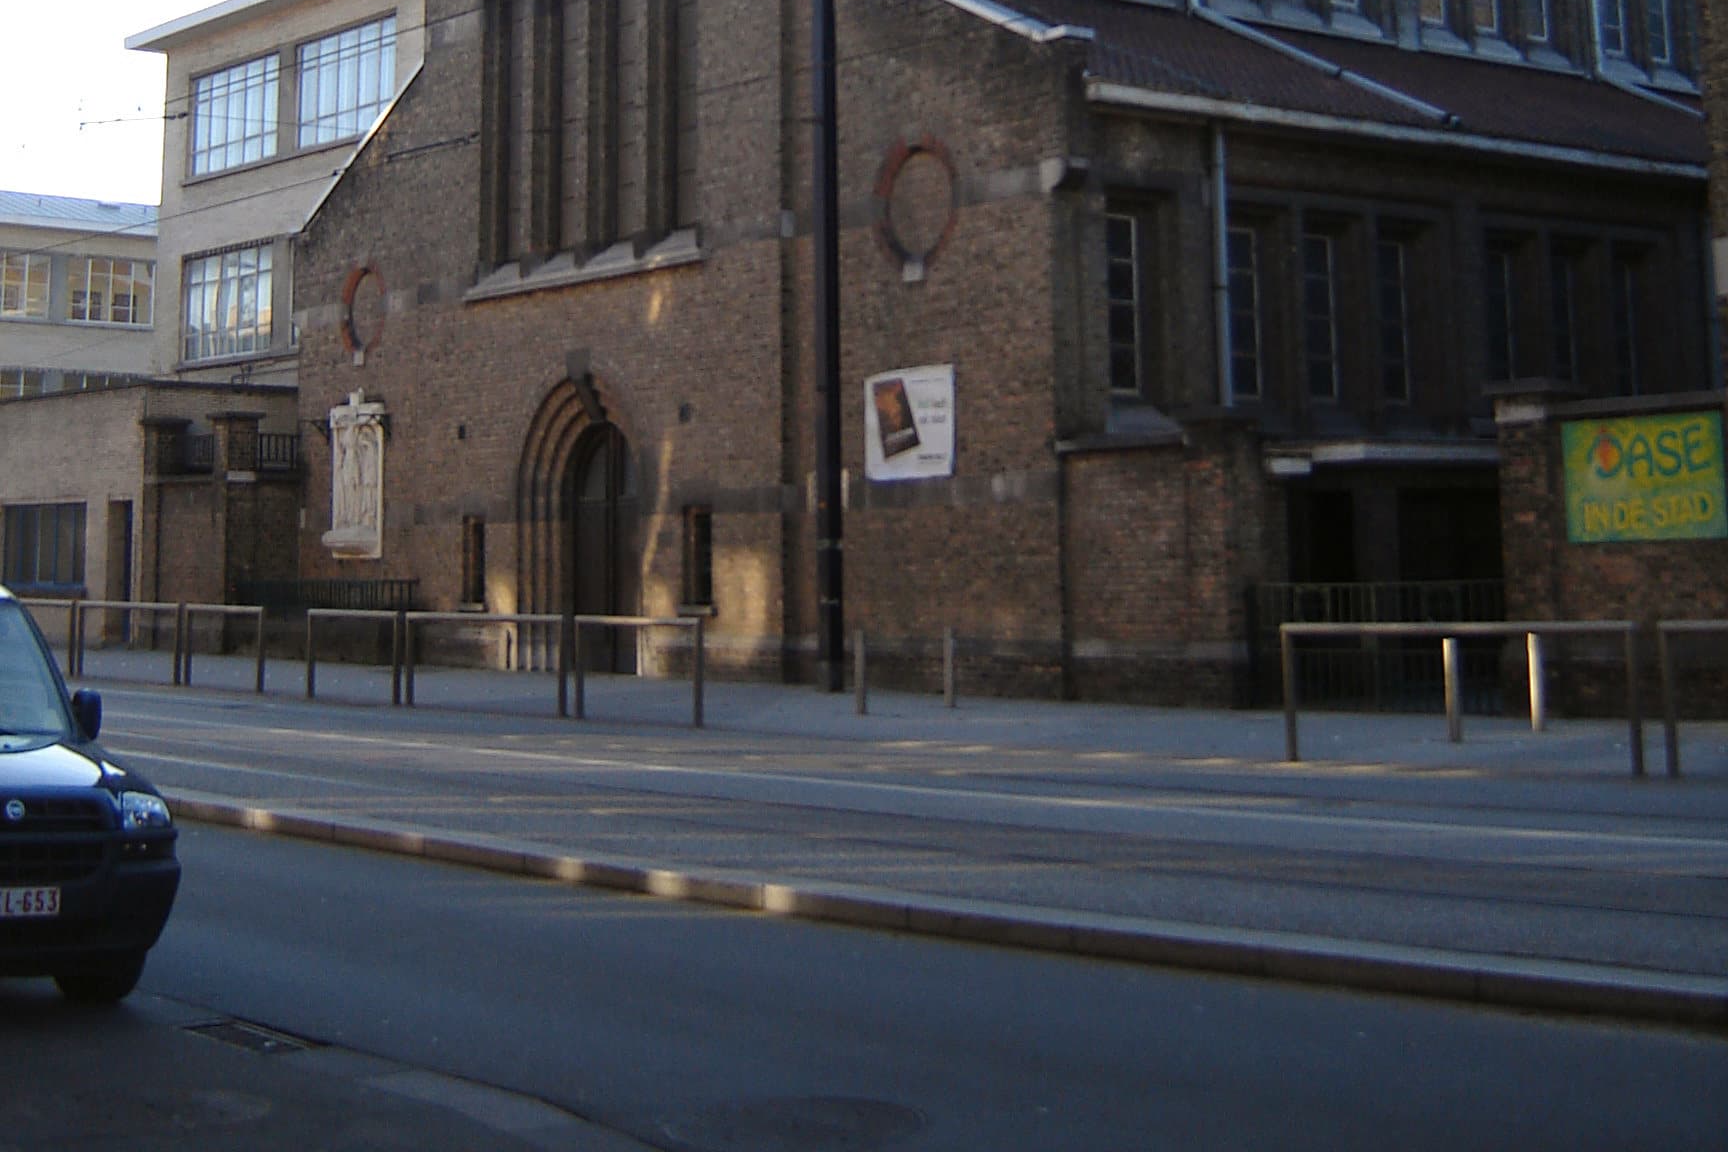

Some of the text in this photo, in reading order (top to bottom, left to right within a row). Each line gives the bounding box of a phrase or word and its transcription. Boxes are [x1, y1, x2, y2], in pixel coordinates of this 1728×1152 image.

[1586, 422, 1711, 479] OASE
[1583, 491, 1714, 533] IN DE STAD
[0, 890, 58, 913] L-653
